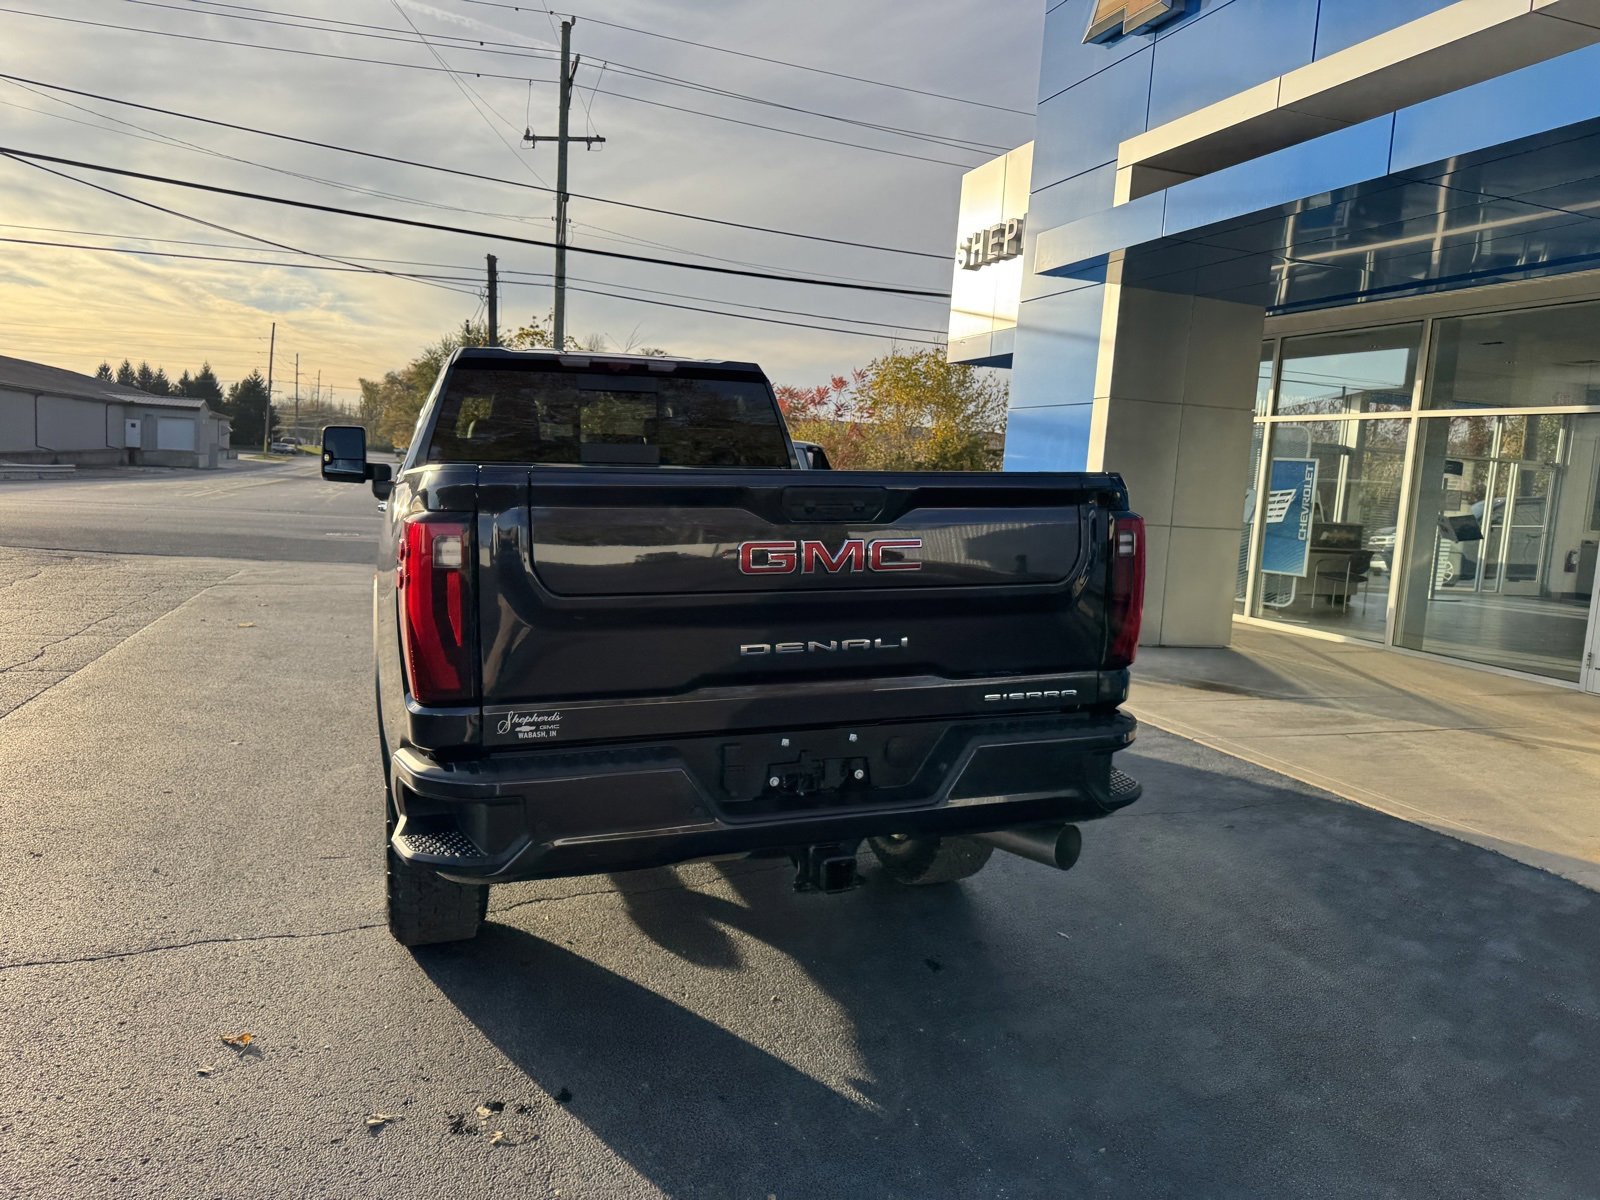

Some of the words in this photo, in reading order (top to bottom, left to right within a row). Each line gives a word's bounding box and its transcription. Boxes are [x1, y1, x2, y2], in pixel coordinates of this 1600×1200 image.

[957, 213, 1027, 271] SHEP
[1297, 464, 1314, 541] CHEVROLET
[738, 538, 922, 576] GMC
[740, 636, 909, 656] DENALI
[984, 689, 1078, 702] SIERRA
